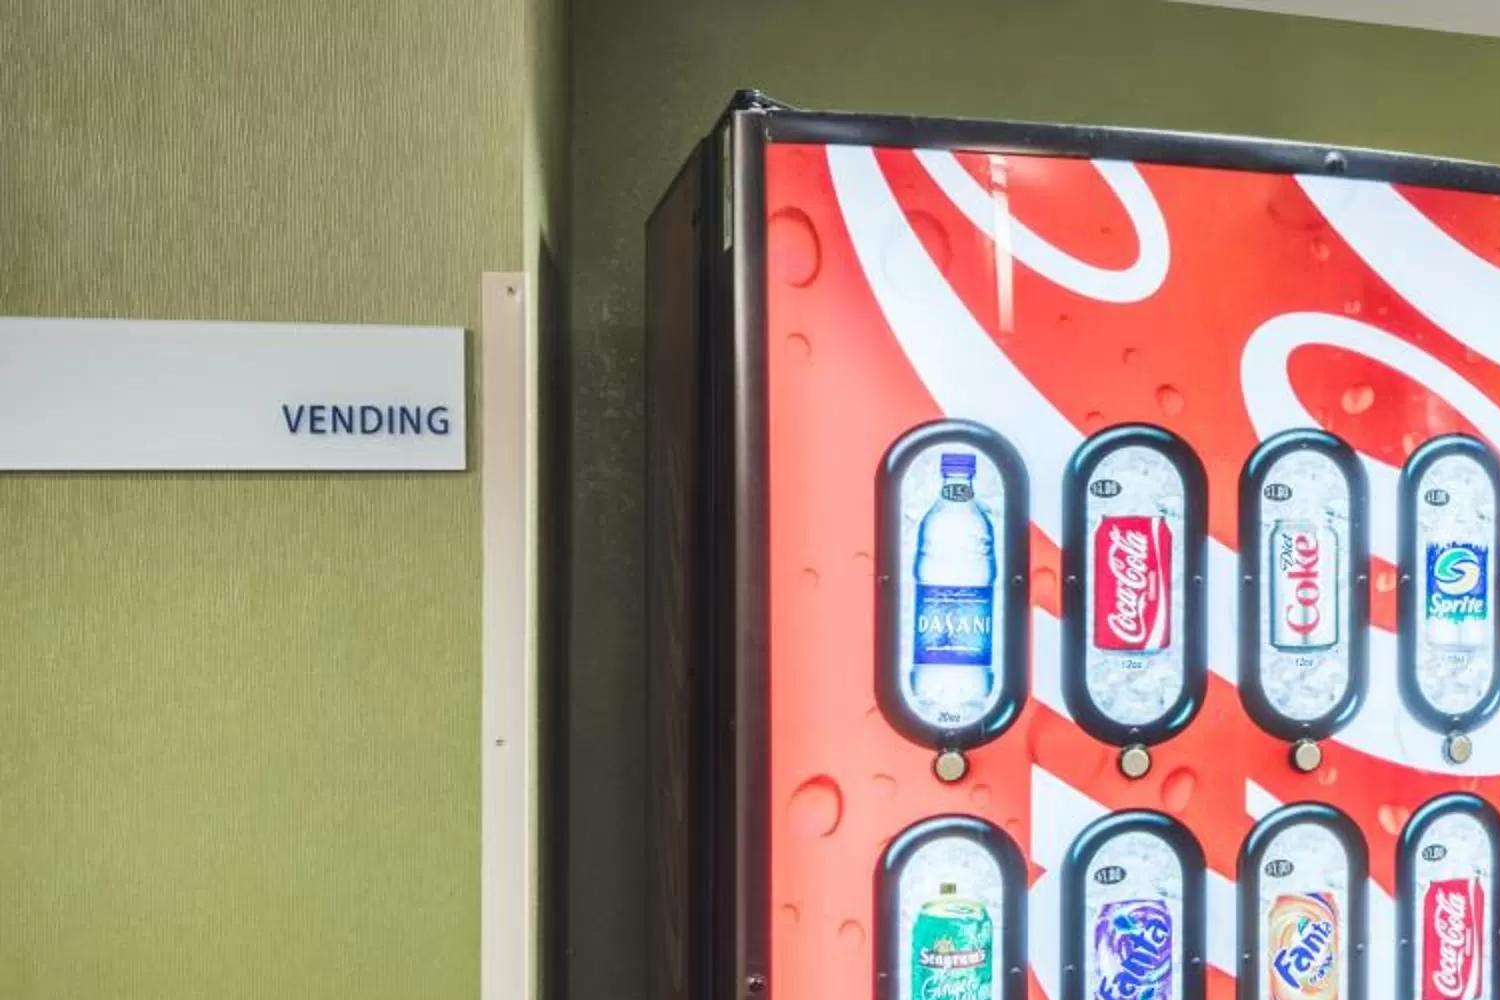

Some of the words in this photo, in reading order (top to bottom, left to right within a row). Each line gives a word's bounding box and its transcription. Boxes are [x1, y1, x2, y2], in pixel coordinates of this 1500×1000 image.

[282, 404, 450, 435] VENDING
[1281, 533, 1294, 571] Diet
[1285, 534, 1320, 635] Coke
[1429, 595, 1484, 617] Sprite
[918, 613, 990, 637] DASANI
[1273, 921, 1333, 990] Fanta
